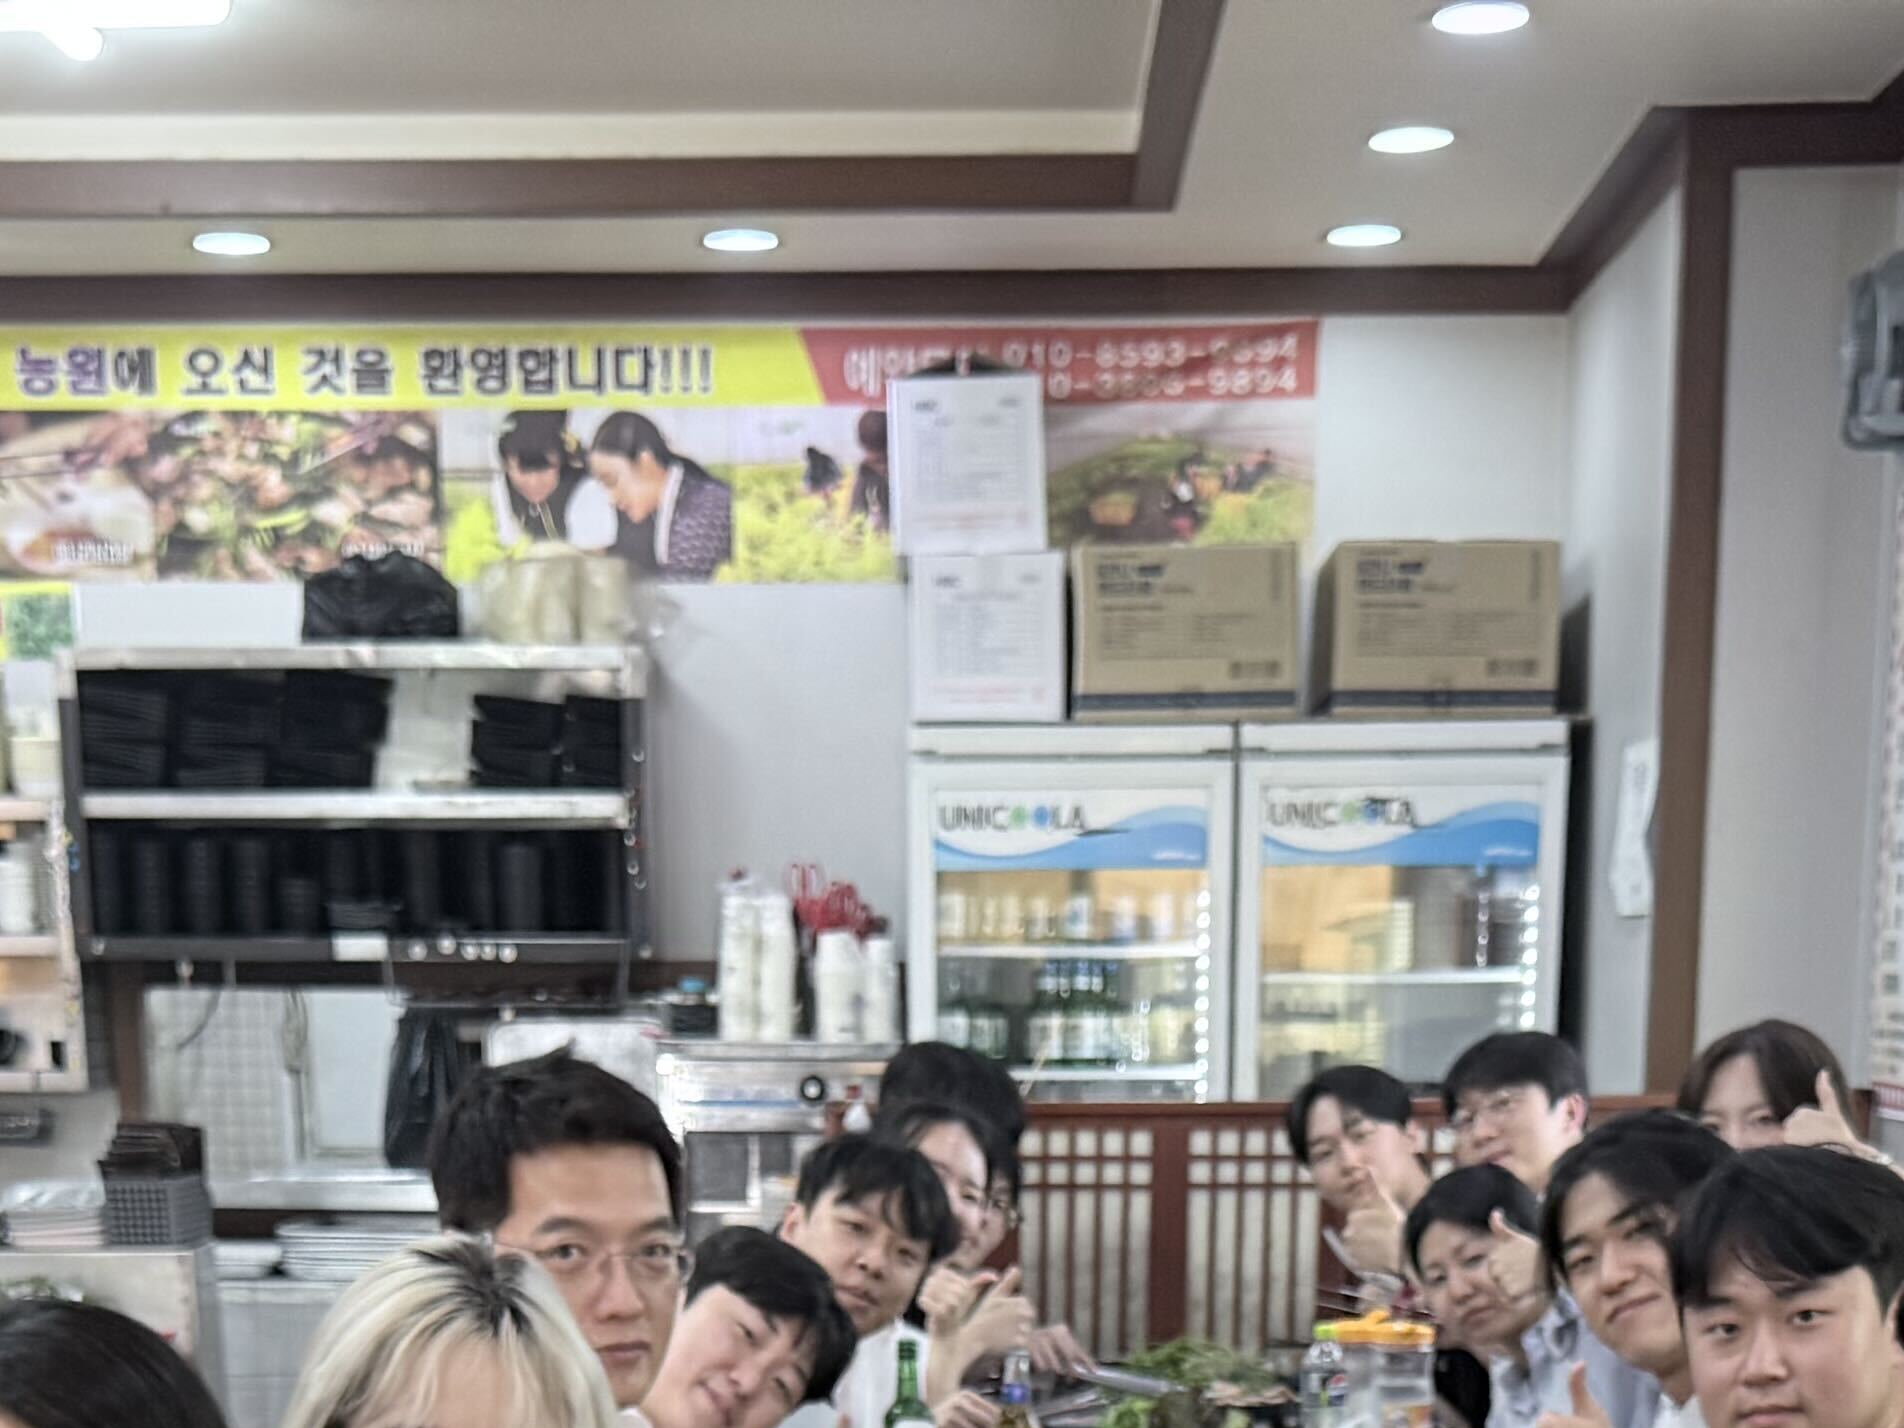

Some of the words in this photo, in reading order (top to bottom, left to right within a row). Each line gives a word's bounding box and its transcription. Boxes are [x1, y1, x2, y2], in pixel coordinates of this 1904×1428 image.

[15, 344, 157, 397] 농원에
[182, 344, 277, 397] 오신
[301, 345, 395, 396] 것을
[420, 344, 714, 396] 환영합니다!!!
